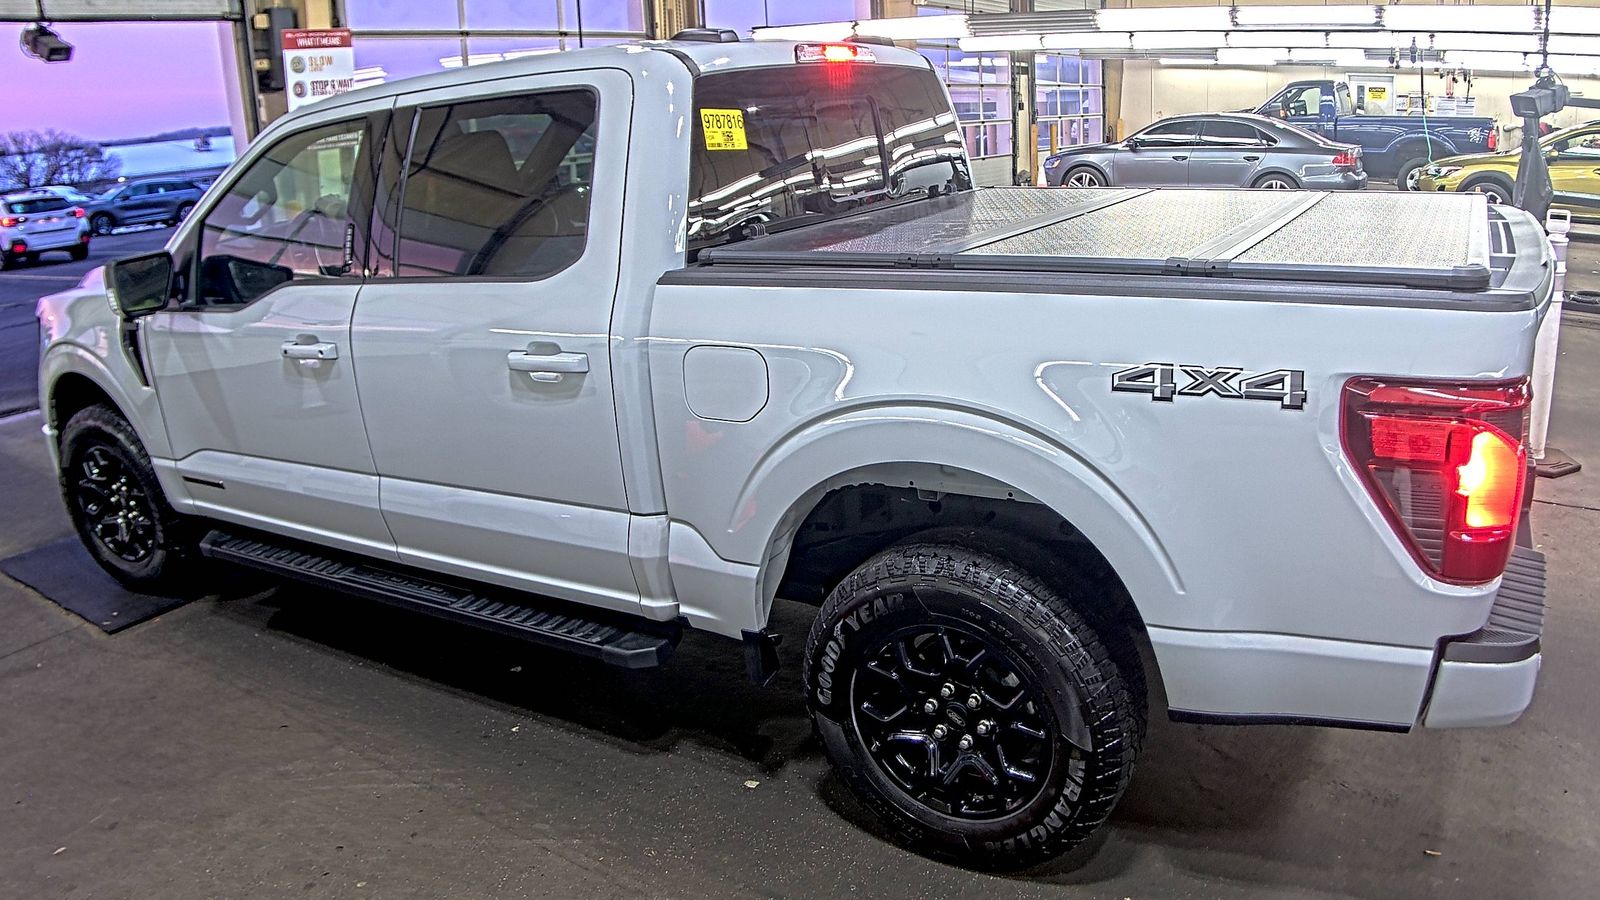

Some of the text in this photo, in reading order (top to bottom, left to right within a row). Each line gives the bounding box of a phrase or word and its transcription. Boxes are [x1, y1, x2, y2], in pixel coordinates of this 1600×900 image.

[296, 37, 313, 47] WHAT
[308, 56, 333, 66] SLOW
[310, 80, 329, 91] STOP
[337, 78, 354, 88] WAIT
[703, 113, 744, 129] 9787816
